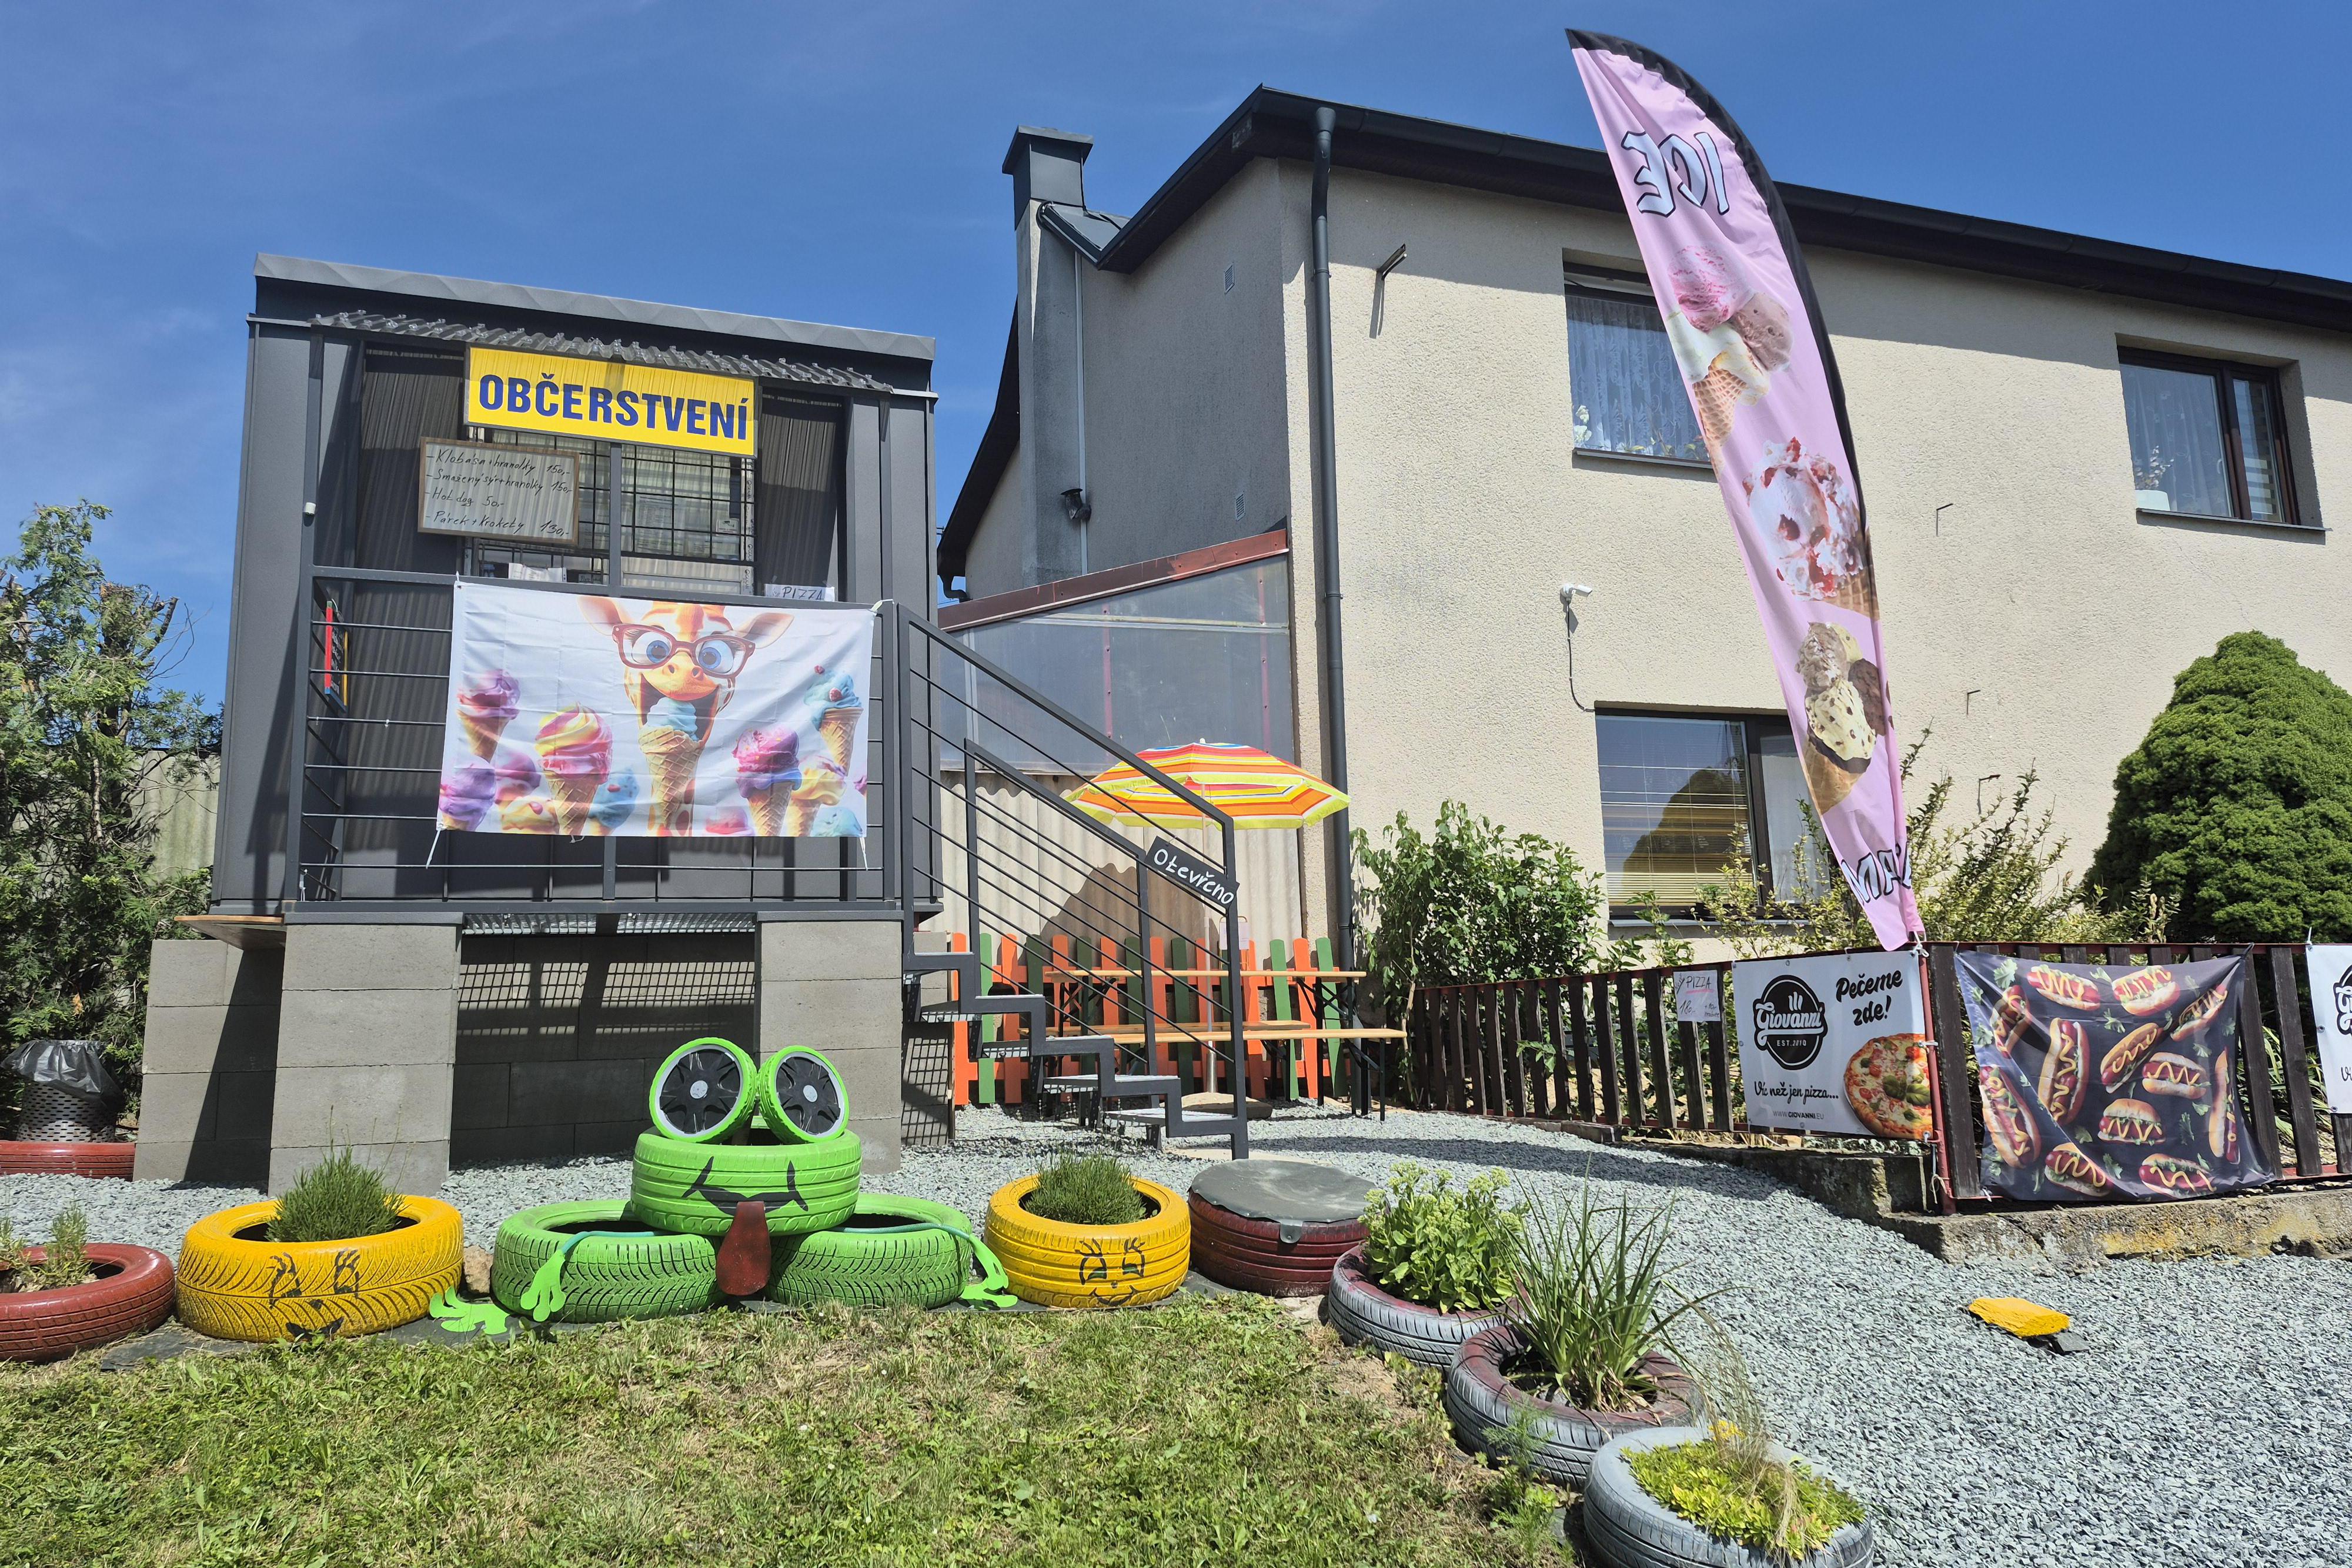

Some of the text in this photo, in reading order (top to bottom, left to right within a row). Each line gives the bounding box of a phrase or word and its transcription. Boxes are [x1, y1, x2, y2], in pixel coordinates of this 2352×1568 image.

[479, 372, 749, 440] OBČERSTVENÍ
[494, 454, 536, 476] hranolky
[432, 487, 453, 500] Hot
[456, 492, 473, 507] dog
[433, 511, 470, 525] Párek
[782, 586, 824, 600] PIZZA
[1154, 848, 1234, 904] Otevřeno
[1686, 975, 1712, 989] PIZZA
[1836, 970, 1903, 1002] Pečeme
[1853, 995, 1892, 1026] zde!
[1756, 1002, 1823, 1046] Giovanni
[1770, 1081, 1788, 1096] než
[1787, 1084, 1803, 1104] jen
[1803, 1085, 1839, 1105] pizza...
